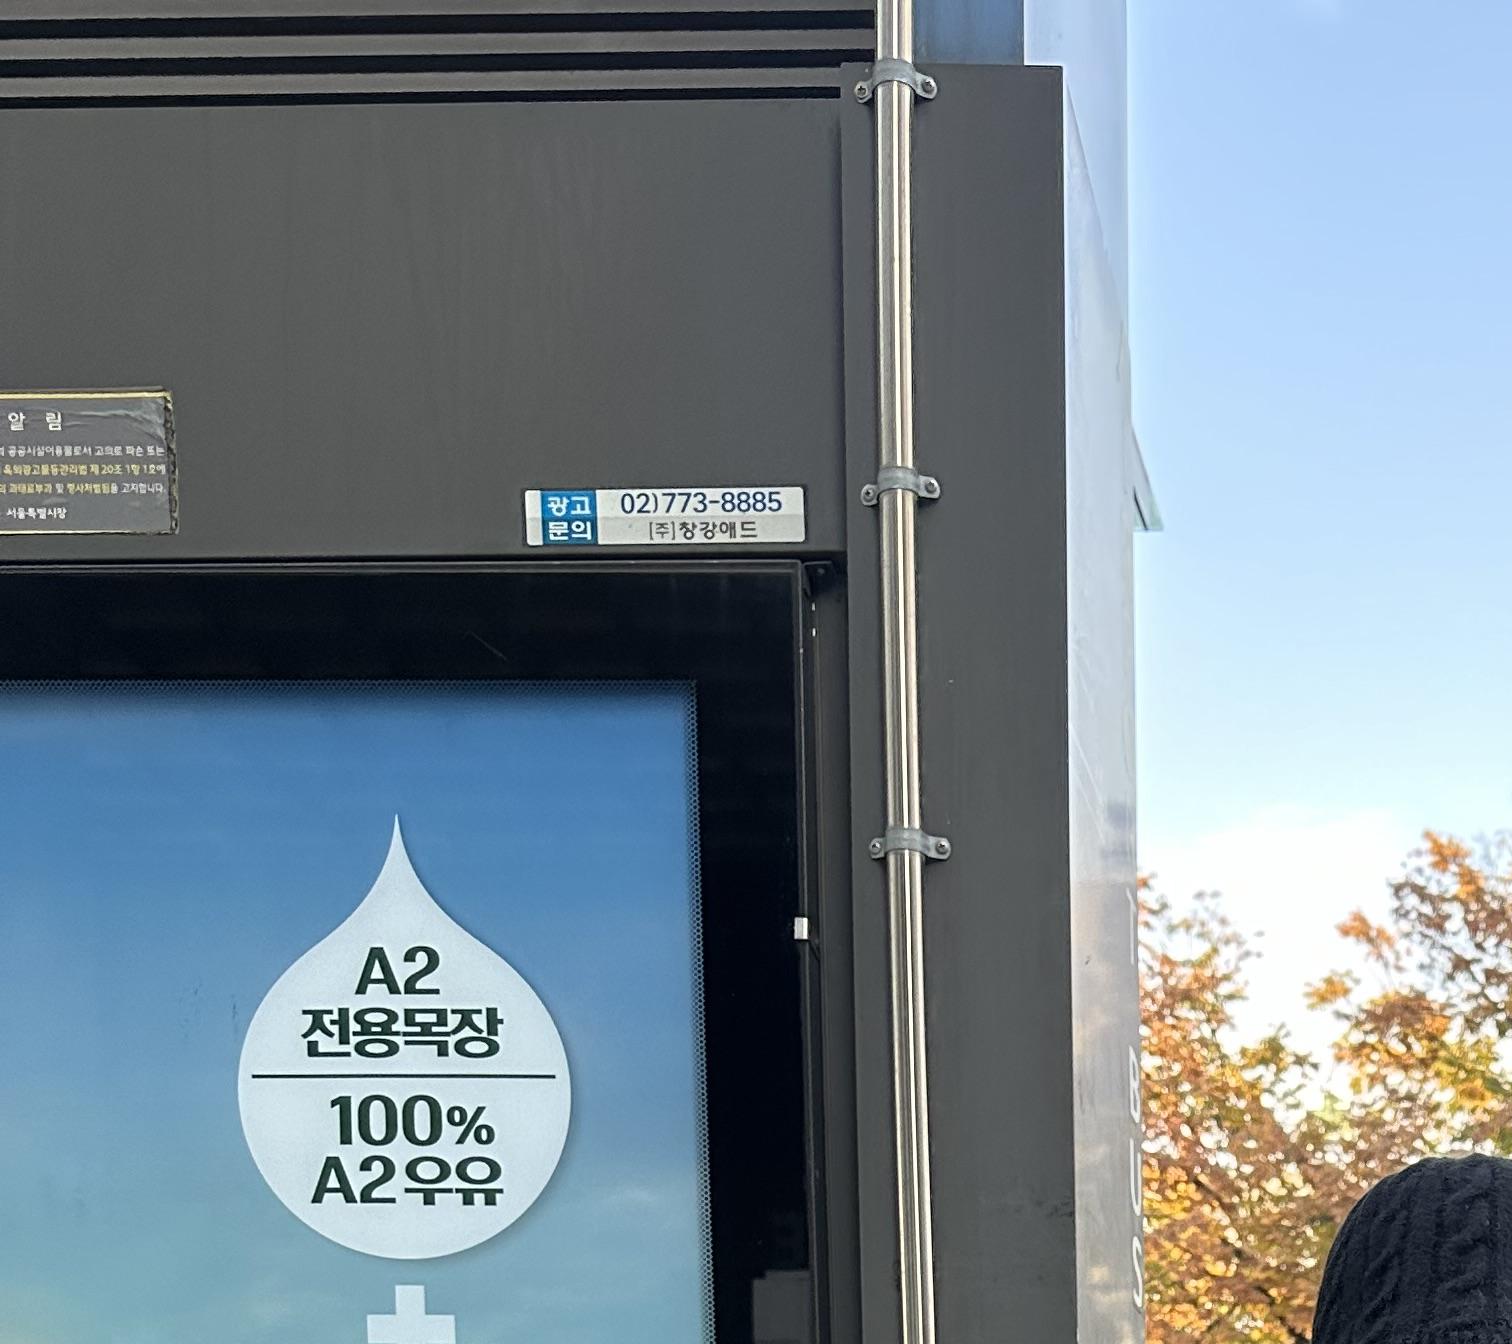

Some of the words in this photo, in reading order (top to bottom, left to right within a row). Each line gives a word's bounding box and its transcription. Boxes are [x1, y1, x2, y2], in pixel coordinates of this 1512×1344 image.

[547, 496, 591, 517] 광고
[620, 491, 782, 514] 02)773-8885
[548, 521, 592, 541] 문의
[354, 945, 440, 996] A2
[301, 1007, 504, 1059] 전용목장
[330, 1094, 496, 1147] 100%
[310, 1155, 504, 1206] A2우유
